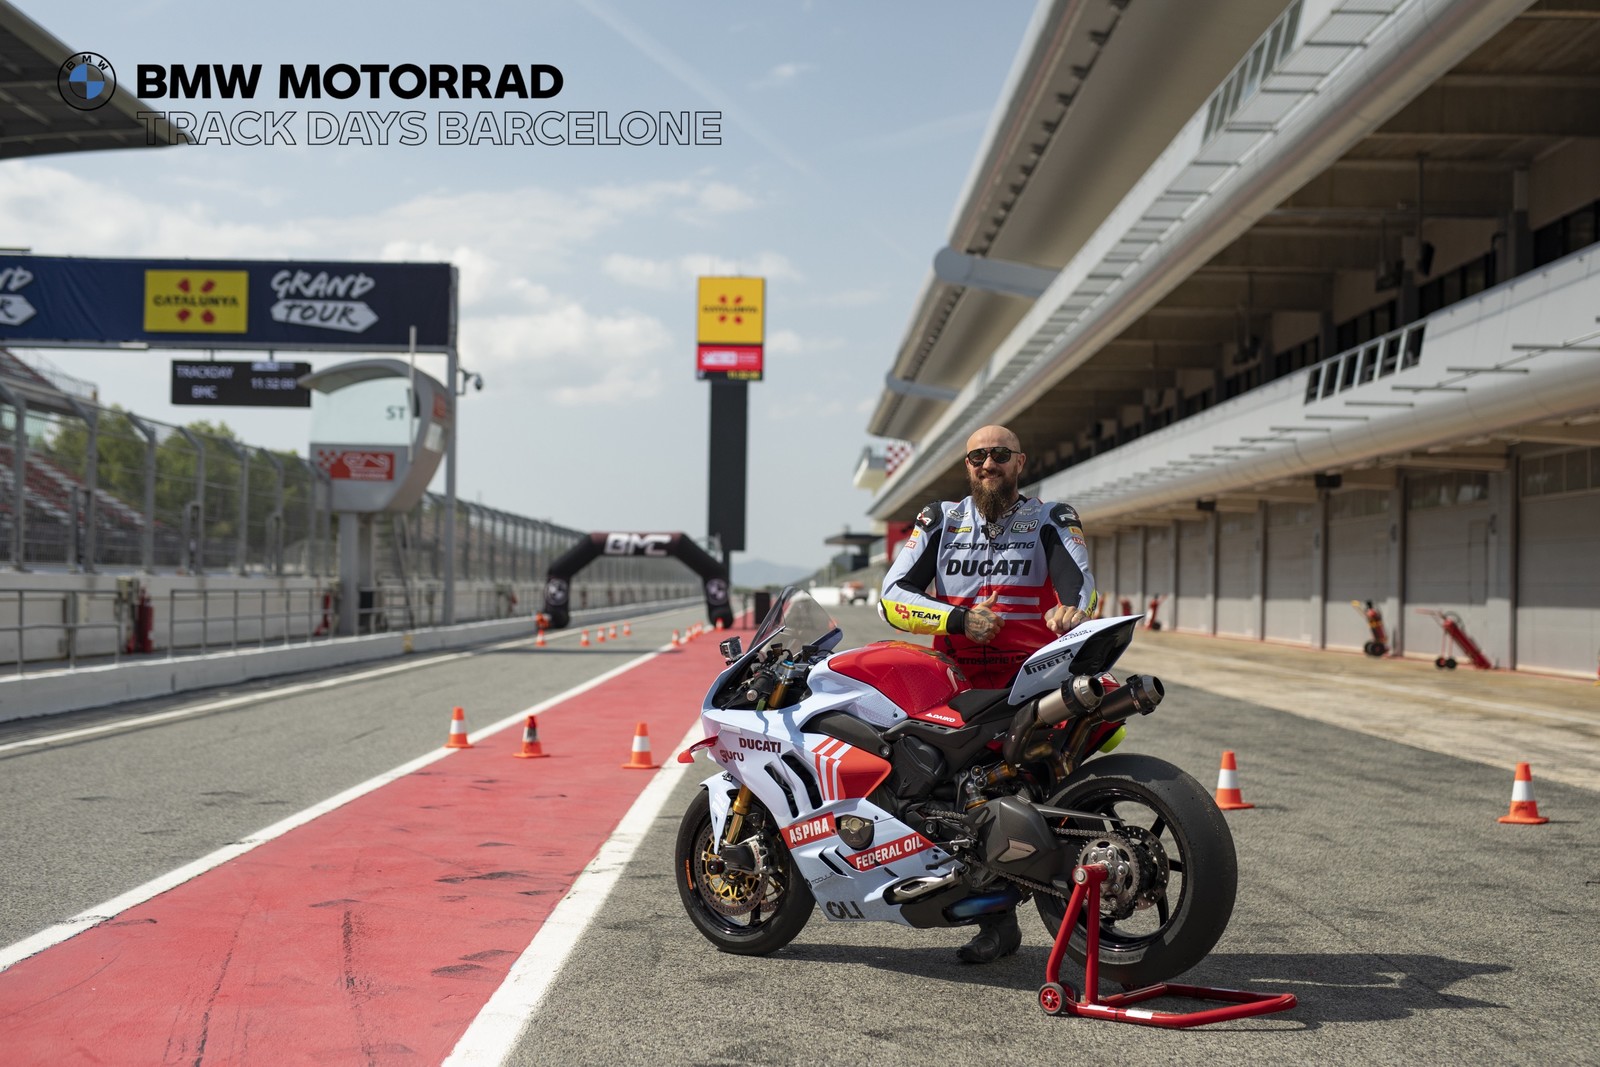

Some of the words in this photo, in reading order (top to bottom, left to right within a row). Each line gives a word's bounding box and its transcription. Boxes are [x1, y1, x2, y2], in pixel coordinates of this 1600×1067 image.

[270, 270, 376, 299] GRAND
[153, 295, 239, 307] CATALUNYA
[283, 303, 359, 325] TOUR
[176, 365, 234, 379] TRACKDAY
[191, 385, 217, 399] BMC
[604, 533, 672, 556] BMC
[989, 541, 1036, 550] RACING
[945, 559, 1032, 576] DUCATI
[911, 610, 941, 621] TEAM
[1023, 648, 1075, 676] PIRELLI
[738, 737, 782, 753] DUCATI
[788, 817, 830, 843] ASPIRA
[855, 847, 902, 870] FEDERAL
[903, 836, 924, 853] OIL
